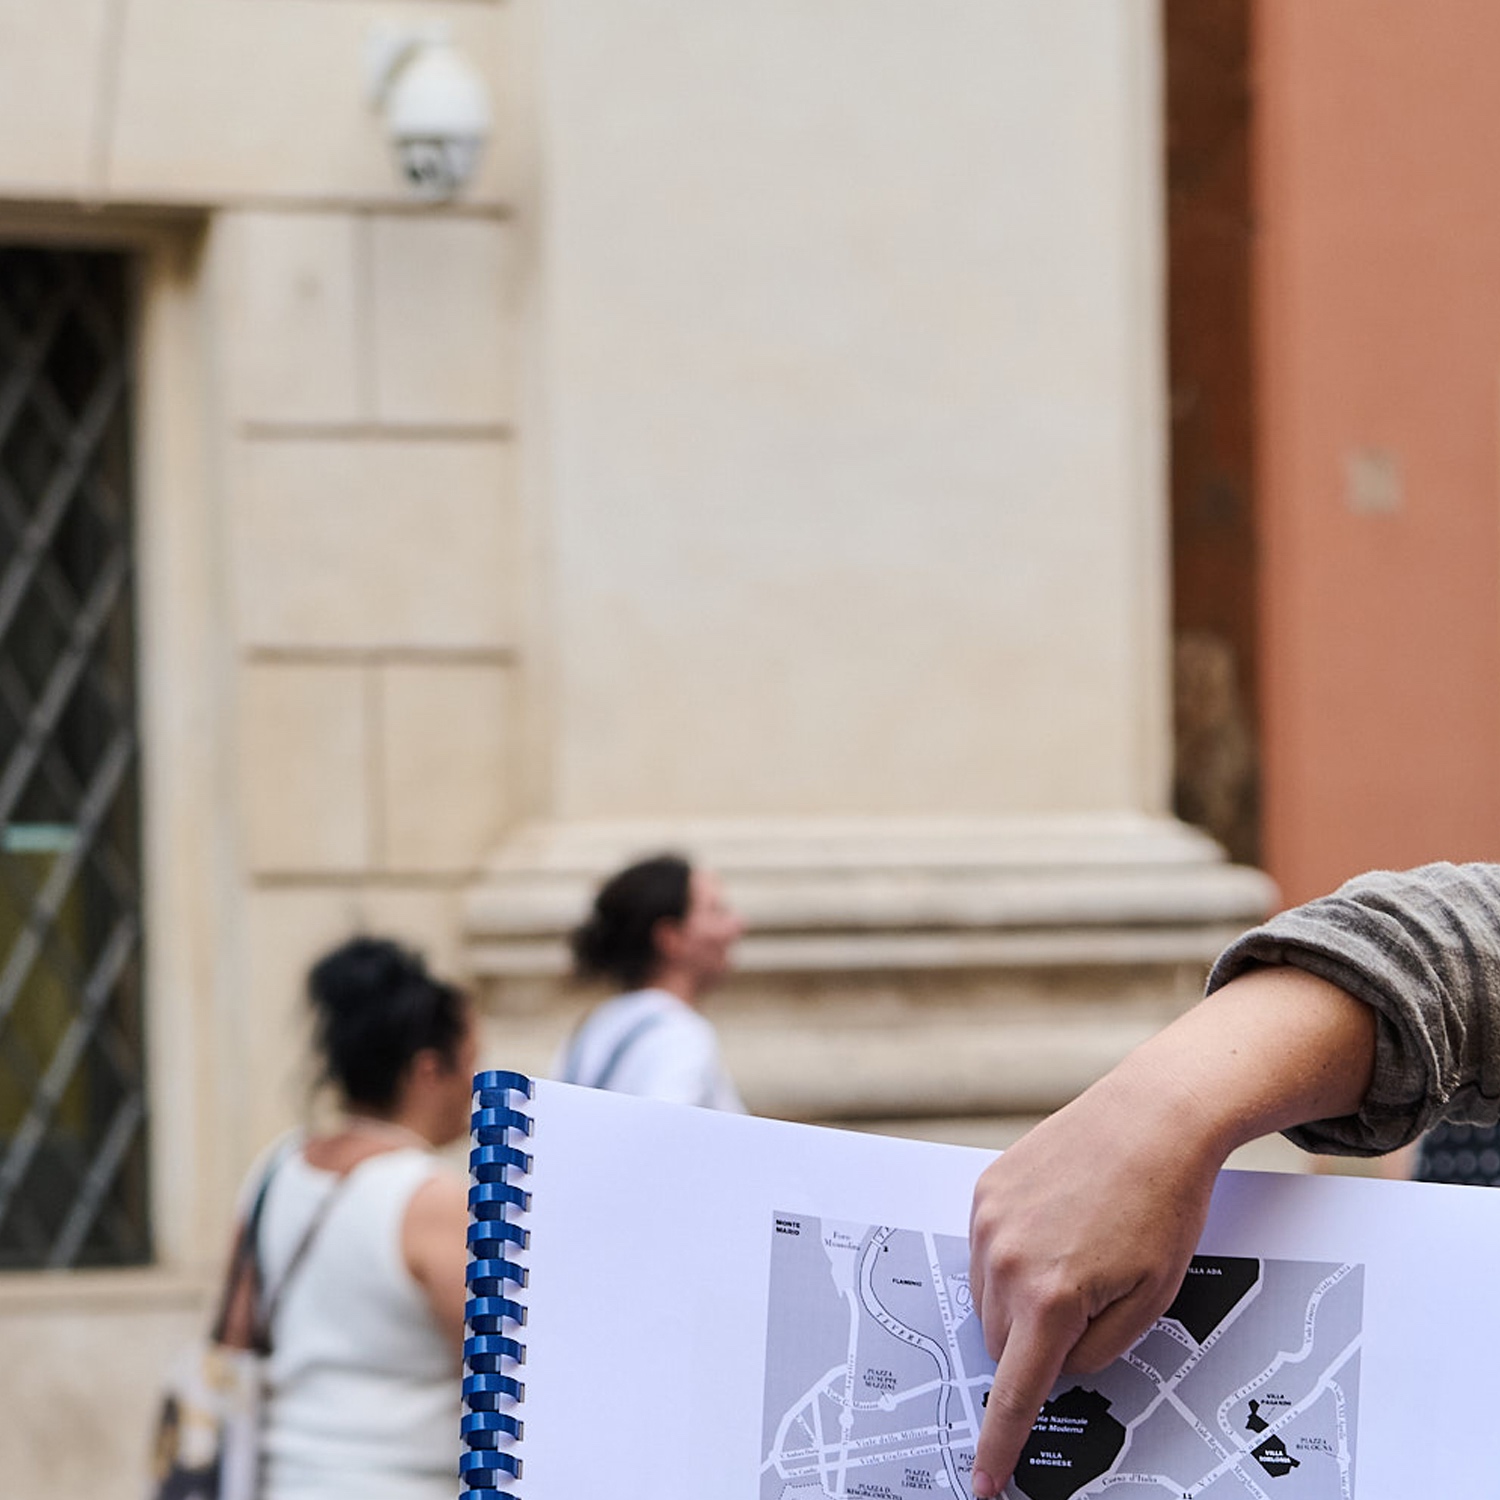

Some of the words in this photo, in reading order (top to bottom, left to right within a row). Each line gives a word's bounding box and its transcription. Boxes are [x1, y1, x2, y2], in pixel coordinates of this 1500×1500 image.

[776, 1219, 800, 1228] MONTE
[776, 1227, 800, 1236] MARIO
[1206, 1268, 1223, 1276] ADA
[866, 1367, 893, 1377] PIAZZA
[1040, 1451, 1062, 1459] VILLA
[1029, 1458, 1073, 1467] BORGHESE
[905, 1468, 931, 1477] PIAZZA
